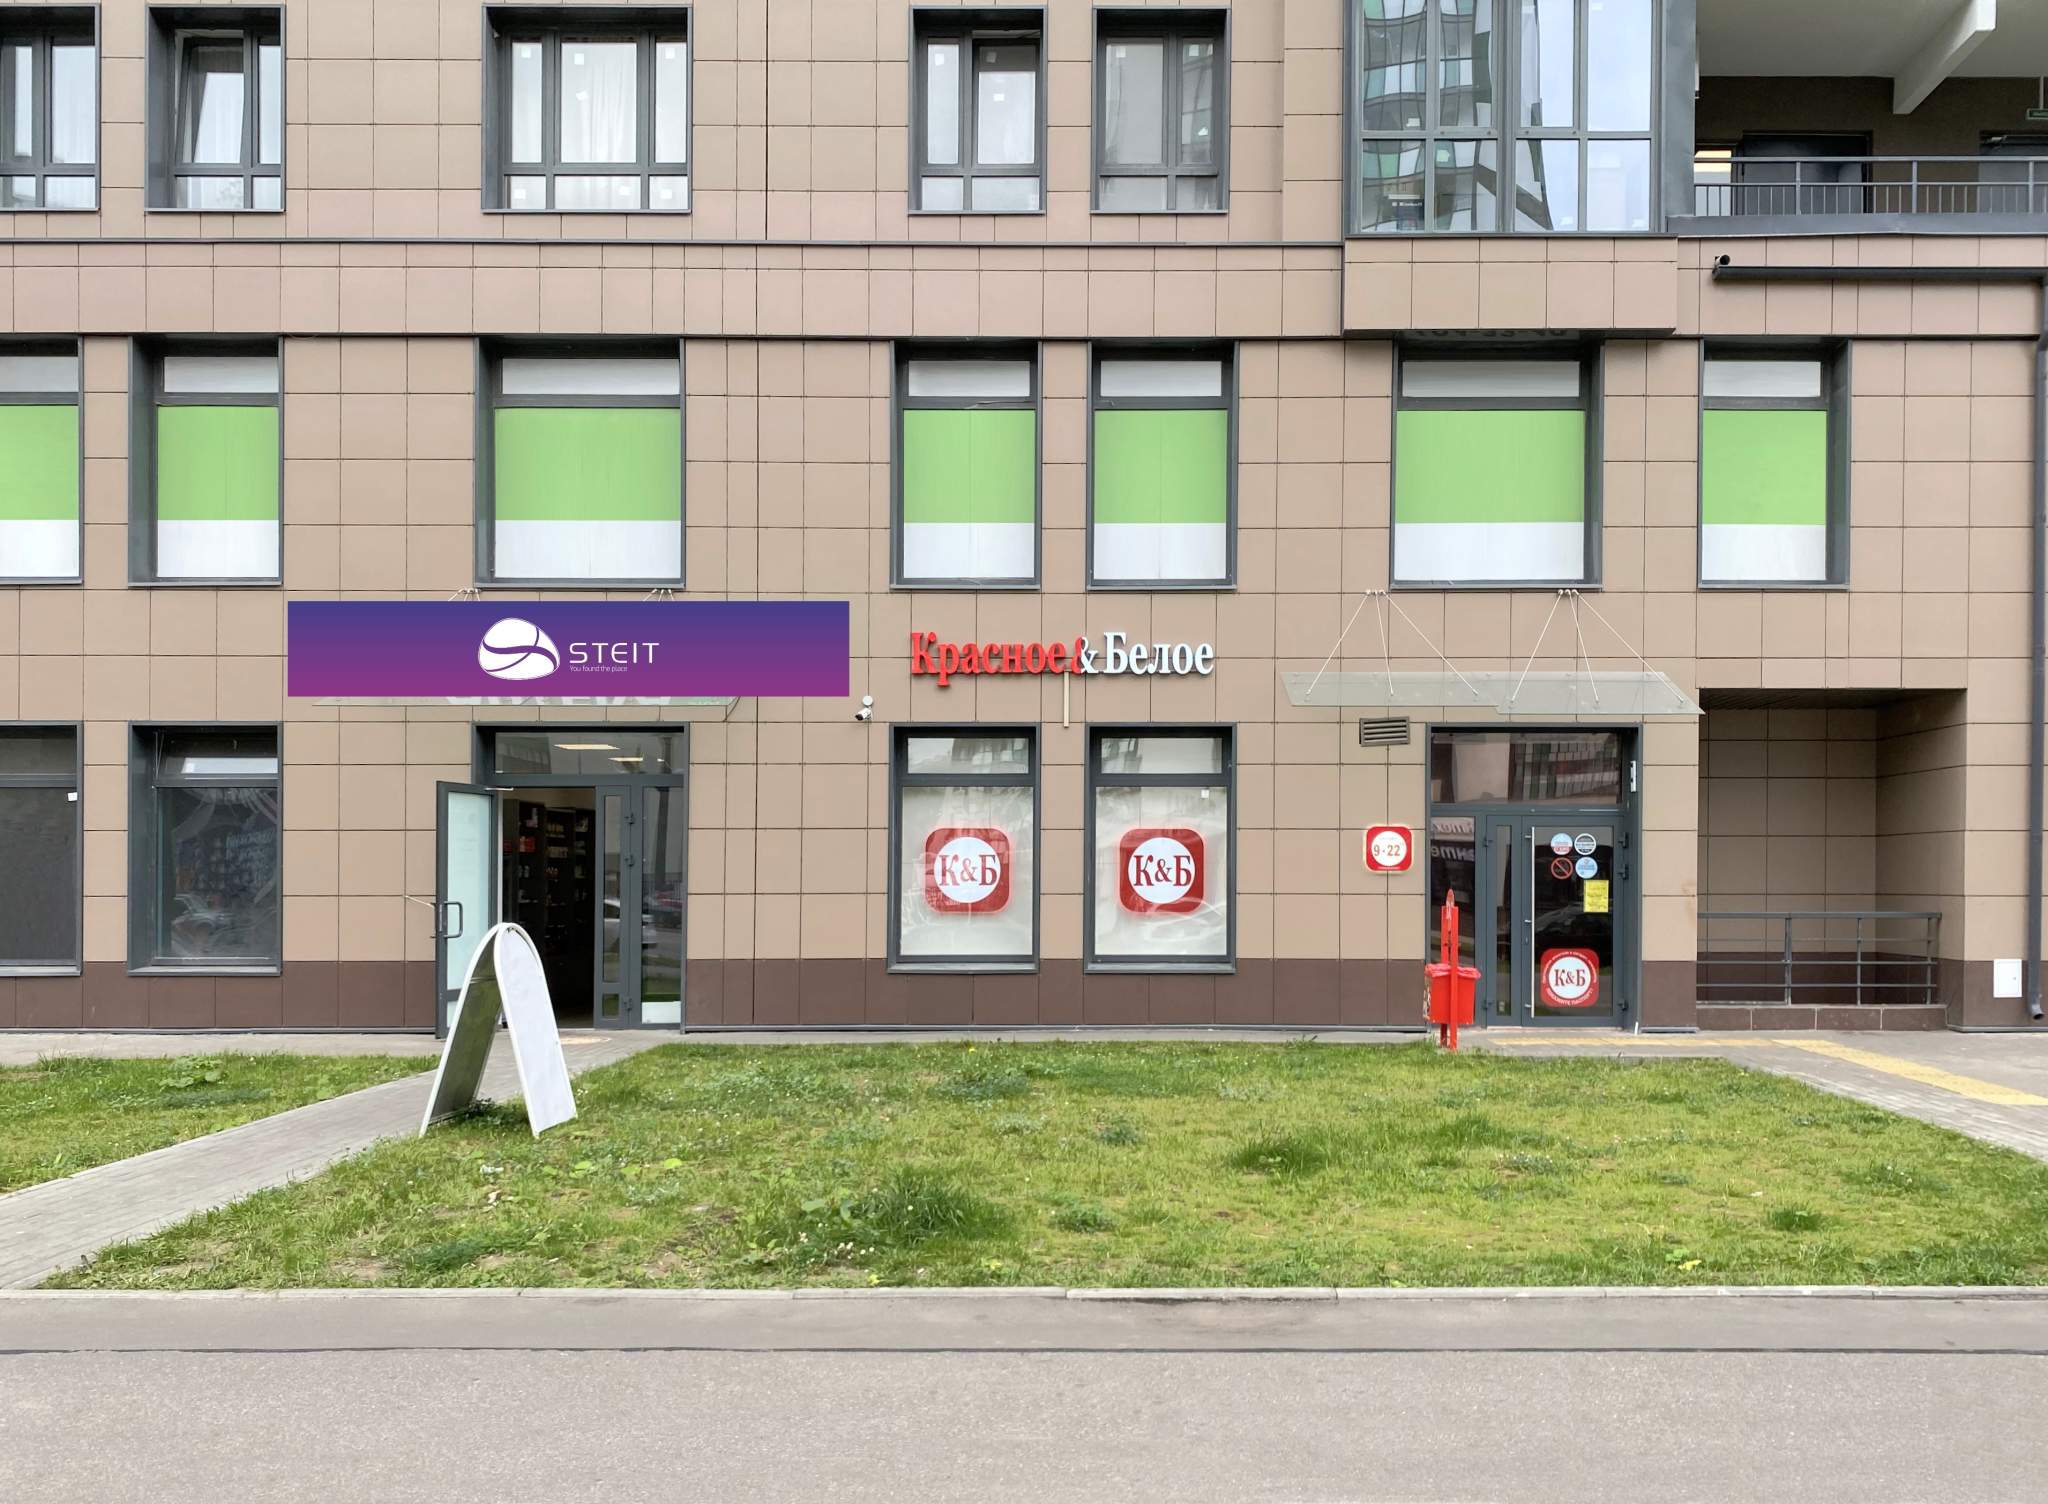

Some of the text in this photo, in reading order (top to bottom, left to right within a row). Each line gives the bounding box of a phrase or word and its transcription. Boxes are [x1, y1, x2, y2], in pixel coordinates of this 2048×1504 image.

[569, 642, 660, 664] STEIT
[938, 854, 998, 886] К&Б
[1132, 854, 1192, 886] К&Б
[1553, 968, 1586, 987] К&Б
